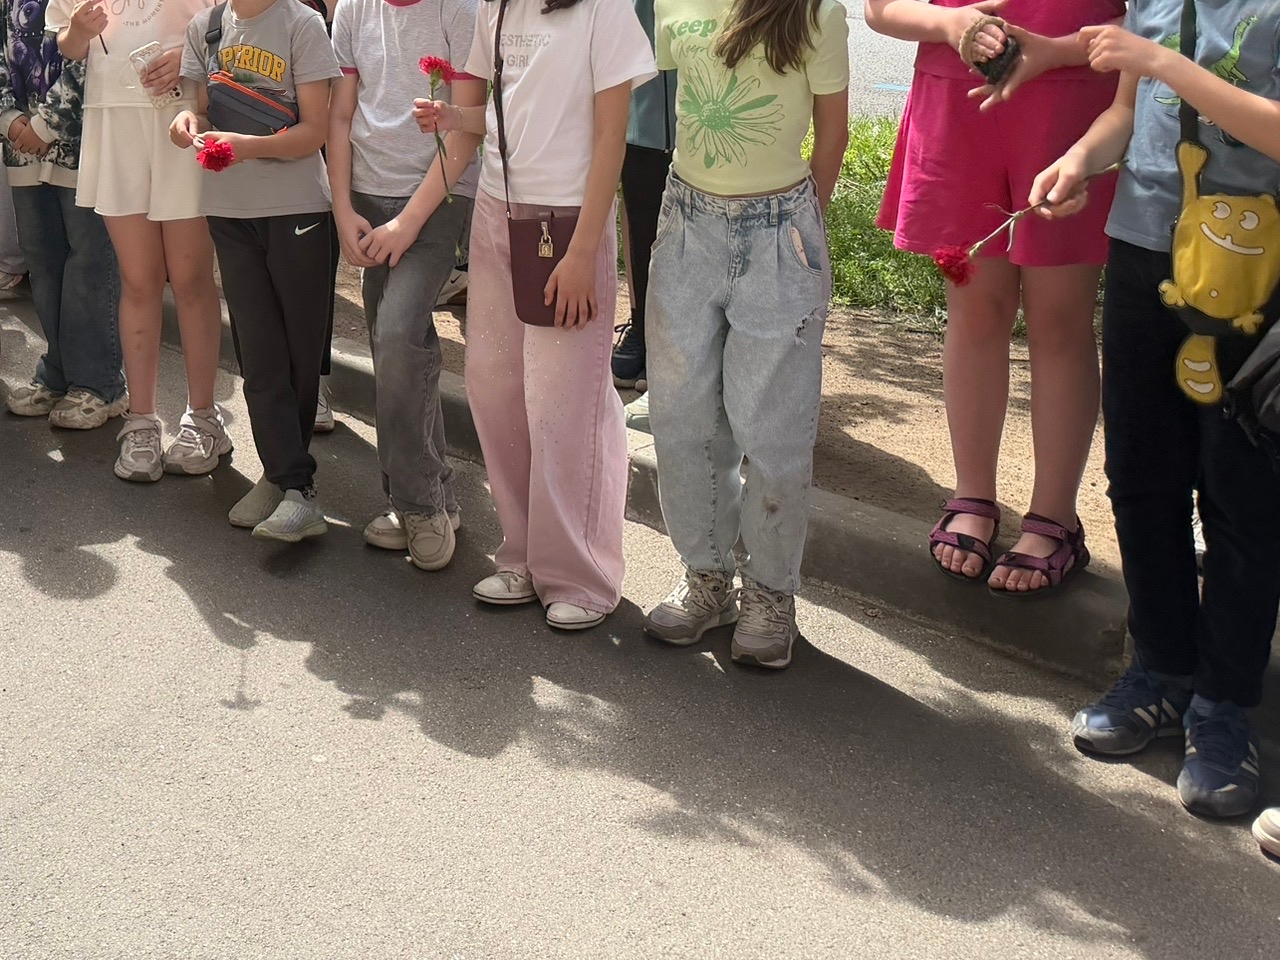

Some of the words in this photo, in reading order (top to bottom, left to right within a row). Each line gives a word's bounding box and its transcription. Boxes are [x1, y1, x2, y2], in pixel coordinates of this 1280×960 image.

[667, 19, 718, 40] Keep
[500, 34, 551, 48] ESTHETIC
[218, 44, 287, 83] PERIOR
[506, 54, 530, 68] GIRL
